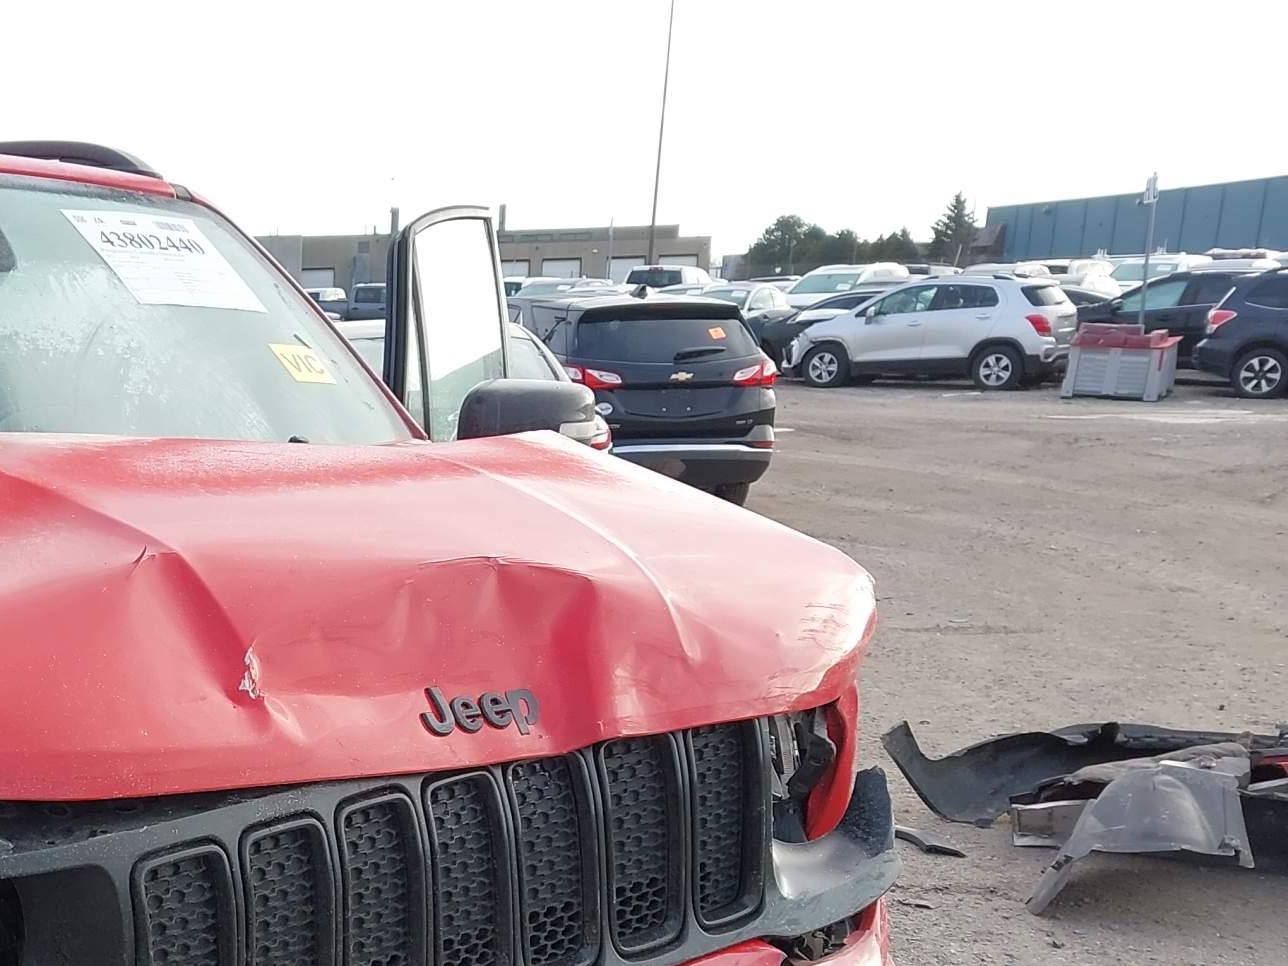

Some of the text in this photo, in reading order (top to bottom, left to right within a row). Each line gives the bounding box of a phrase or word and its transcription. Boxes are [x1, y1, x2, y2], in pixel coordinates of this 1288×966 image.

[99, 230, 206, 255] 43802440
[279, 352, 325, 375] VIC
[419, 685, 539, 738] Jeep
